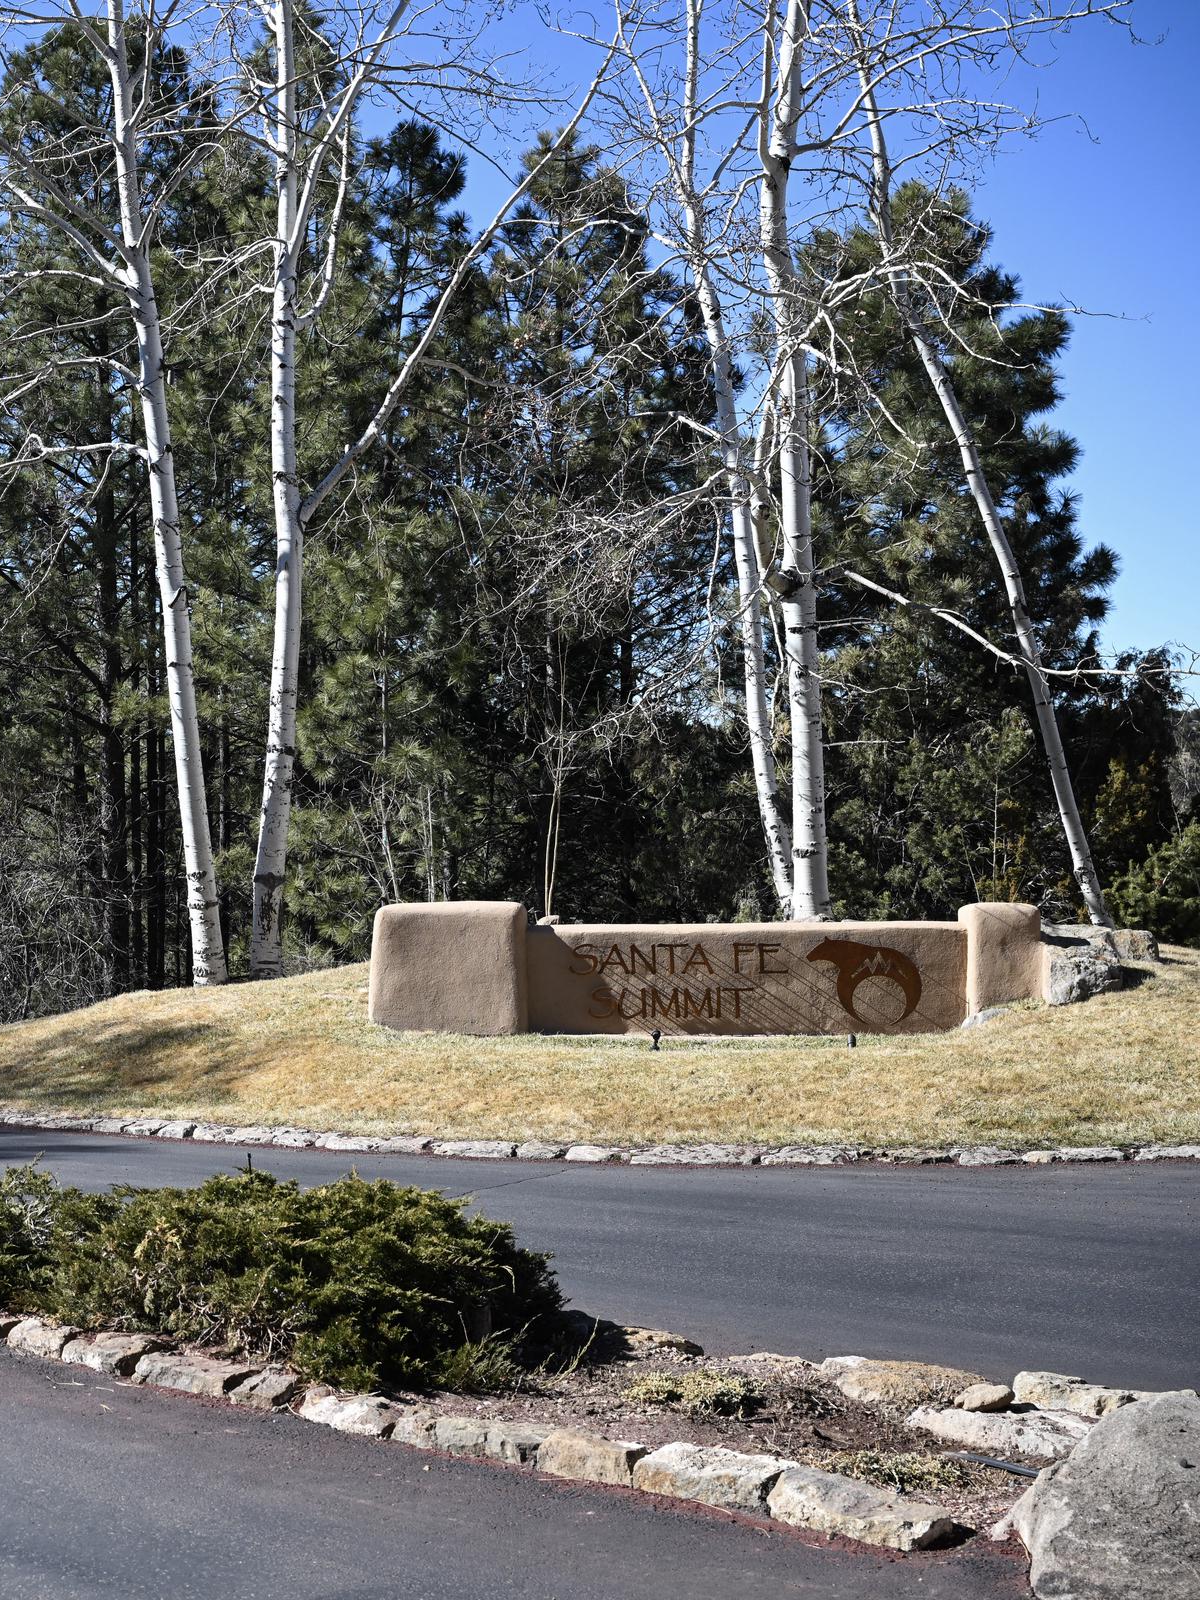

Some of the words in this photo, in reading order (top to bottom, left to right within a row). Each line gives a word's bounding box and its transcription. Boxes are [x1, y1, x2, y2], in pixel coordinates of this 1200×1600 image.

[568, 942, 715, 975] SANTA
[732, 942, 789, 974] FE
[587, 987, 755, 1019] SUMMIT
